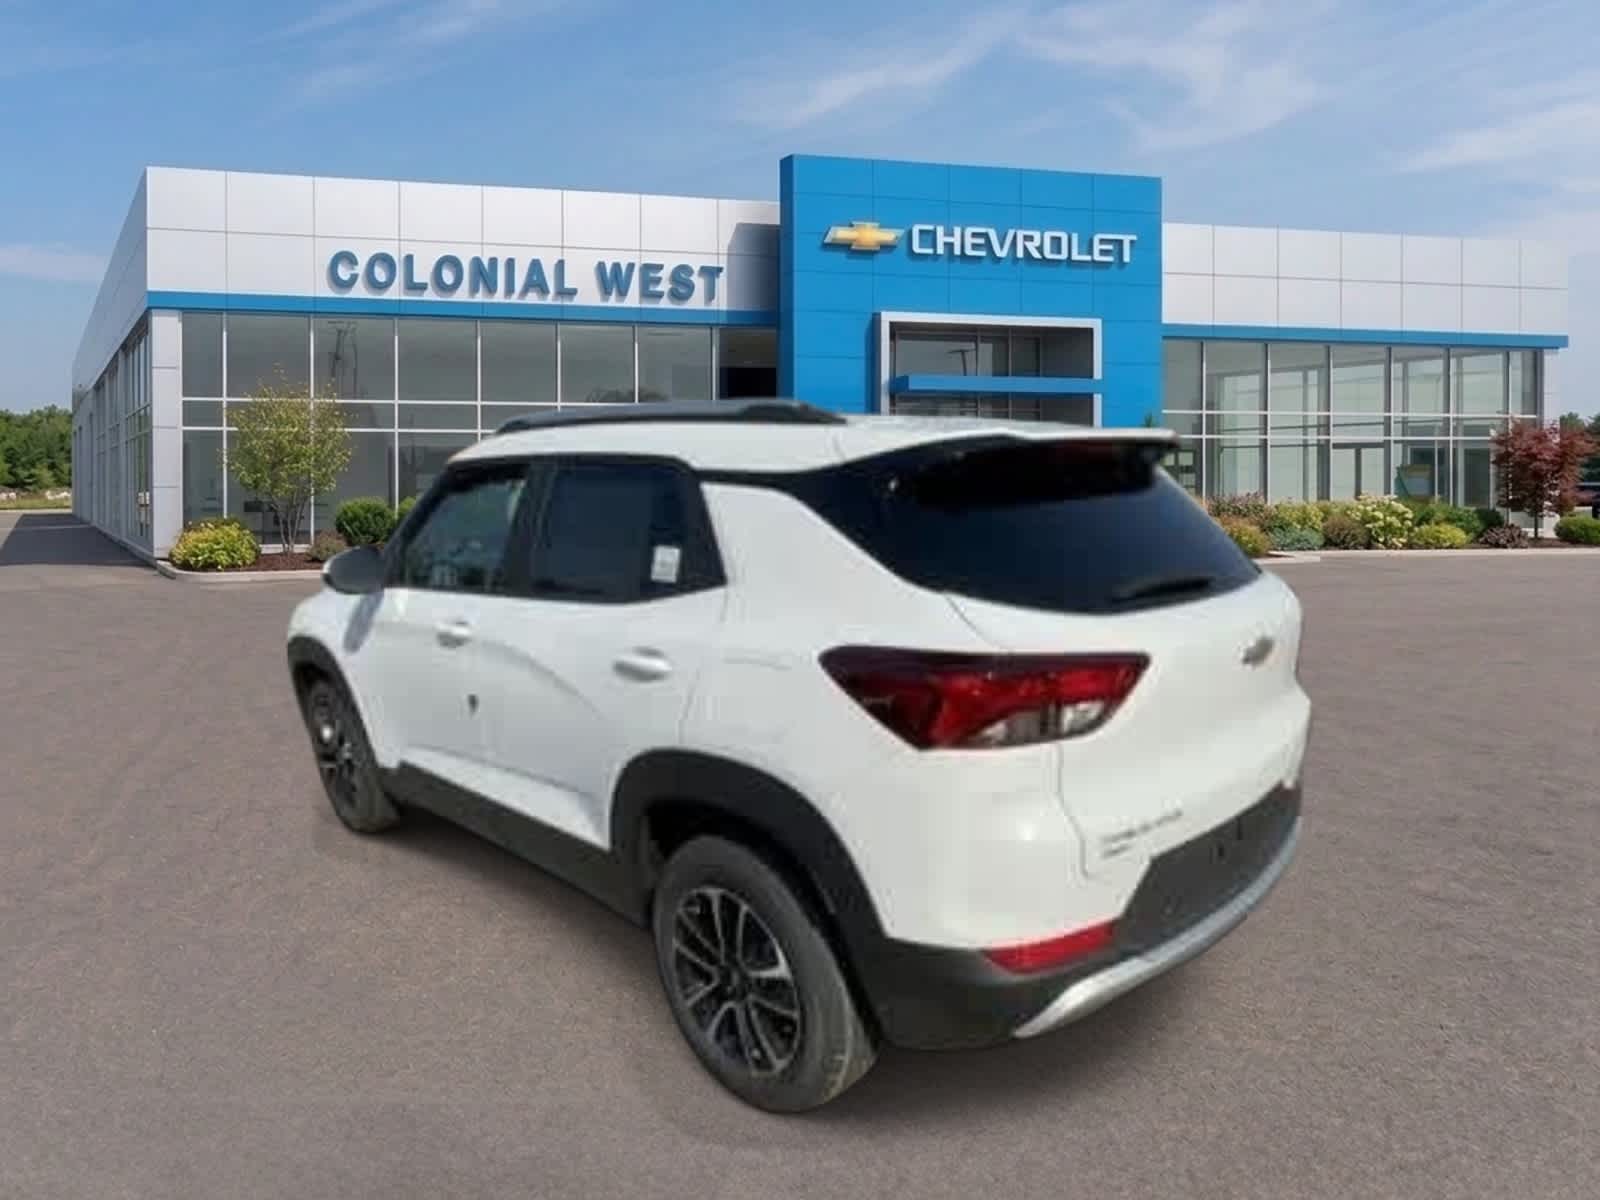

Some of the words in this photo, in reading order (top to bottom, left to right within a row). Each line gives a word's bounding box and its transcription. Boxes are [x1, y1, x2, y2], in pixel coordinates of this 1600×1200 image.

[911, 223, 1138, 264] CHEVROLET
[328, 250, 578, 297] COLONIAL
[595, 260, 724, 303] WEST
